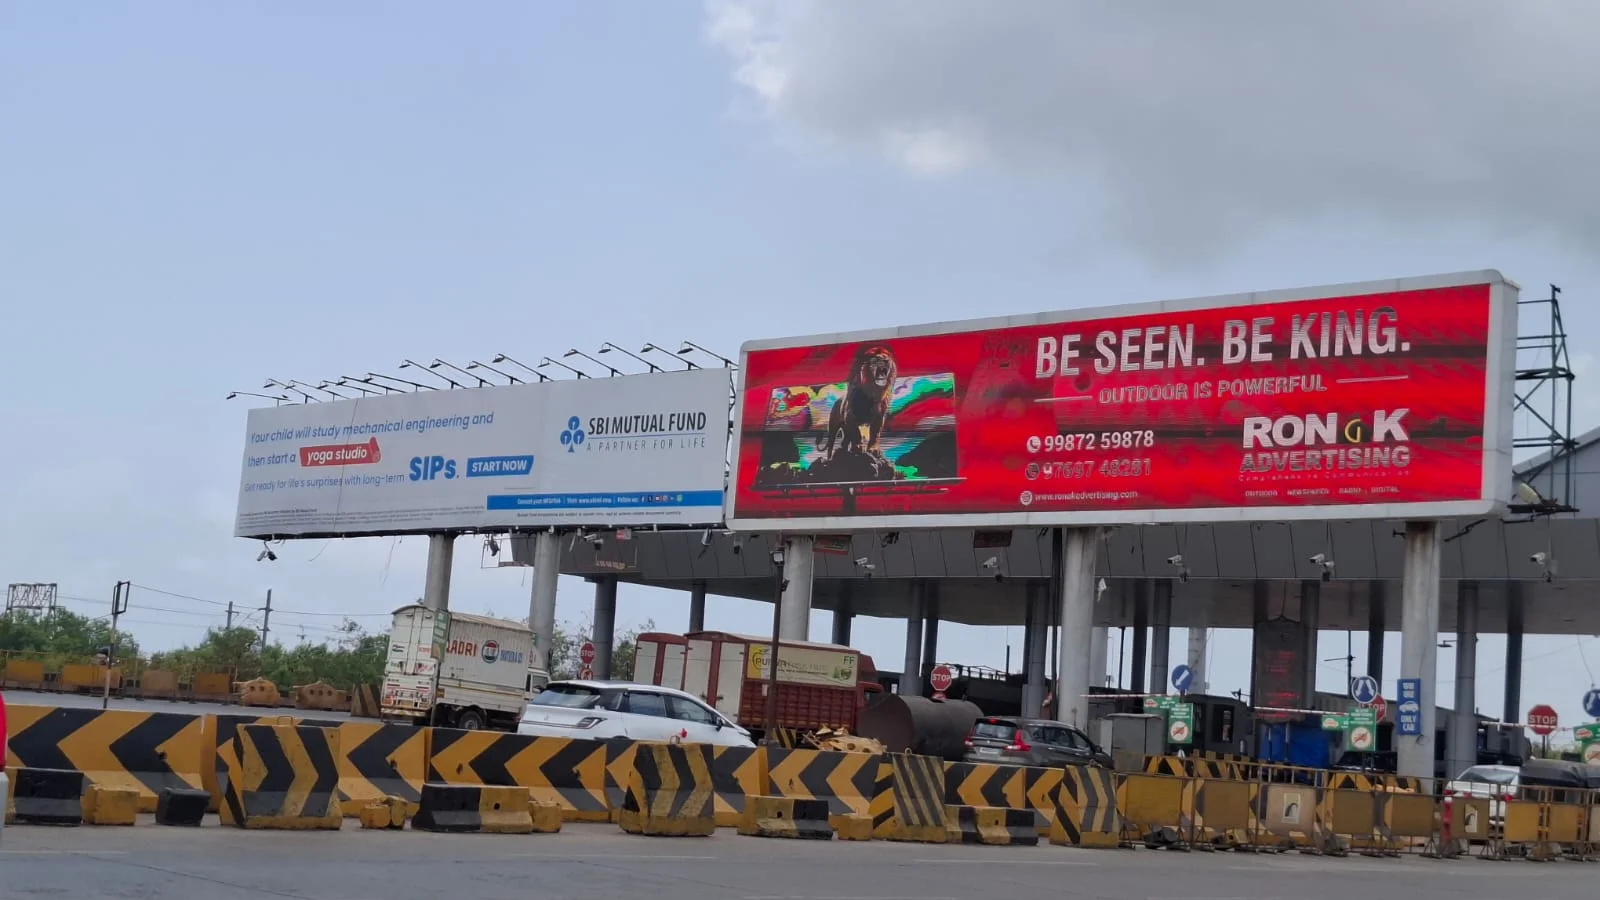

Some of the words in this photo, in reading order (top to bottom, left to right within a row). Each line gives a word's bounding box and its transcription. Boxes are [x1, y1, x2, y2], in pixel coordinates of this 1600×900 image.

[1035, 333, 1081, 379] BE
[1094, 323, 1205, 375] SEEN.
[1222, 317, 1275, 364] BE
[1290, 305, 1411, 360] KING.
[1100, 383, 1188, 404] OUTDOOR
[1194, 381, 1212, 399] IS
[1217, 374, 1327, 398] POWERFUL
[251, 431, 271, 443] Your
[271, 427, 293, 441] child
[295, 427, 311, 439] will
[312, 424, 340, 440] study
[342, 419, 404, 435] mechanical
[405, 414, 470, 433] engineering
[472, 411, 495, 425] and
[588, 417, 609, 436] SBI
[611, 414, 665, 434] MUTUAL
[668, 411, 706, 431] FUND
[598, 439, 646, 452] PARTNER
[654, 438, 674, 449] FOR
[681, 437, 706, 448] LIFE
[1044, 433, 1095, 453] 99872
[1100, 430, 1154, 450] 59878
[247, 455, 265, 468] then
[268, 453, 288, 465] start
[290, 454, 296, 463] a
[307, 450, 333, 466] yoga
[335, 446, 368, 460] studio
[472, 461, 502, 473] START
[502, 459, 528, 471] NOW
[1239, 445, 1411, 474] ADVERTISING
[306, 475, 343, 489] surprises
[344, 474, 361, 486] with
[362, 472, 405, 487] long-term
[932, 673, 951, 682] STOP
[1528, 715, 1557, 724] STOP
